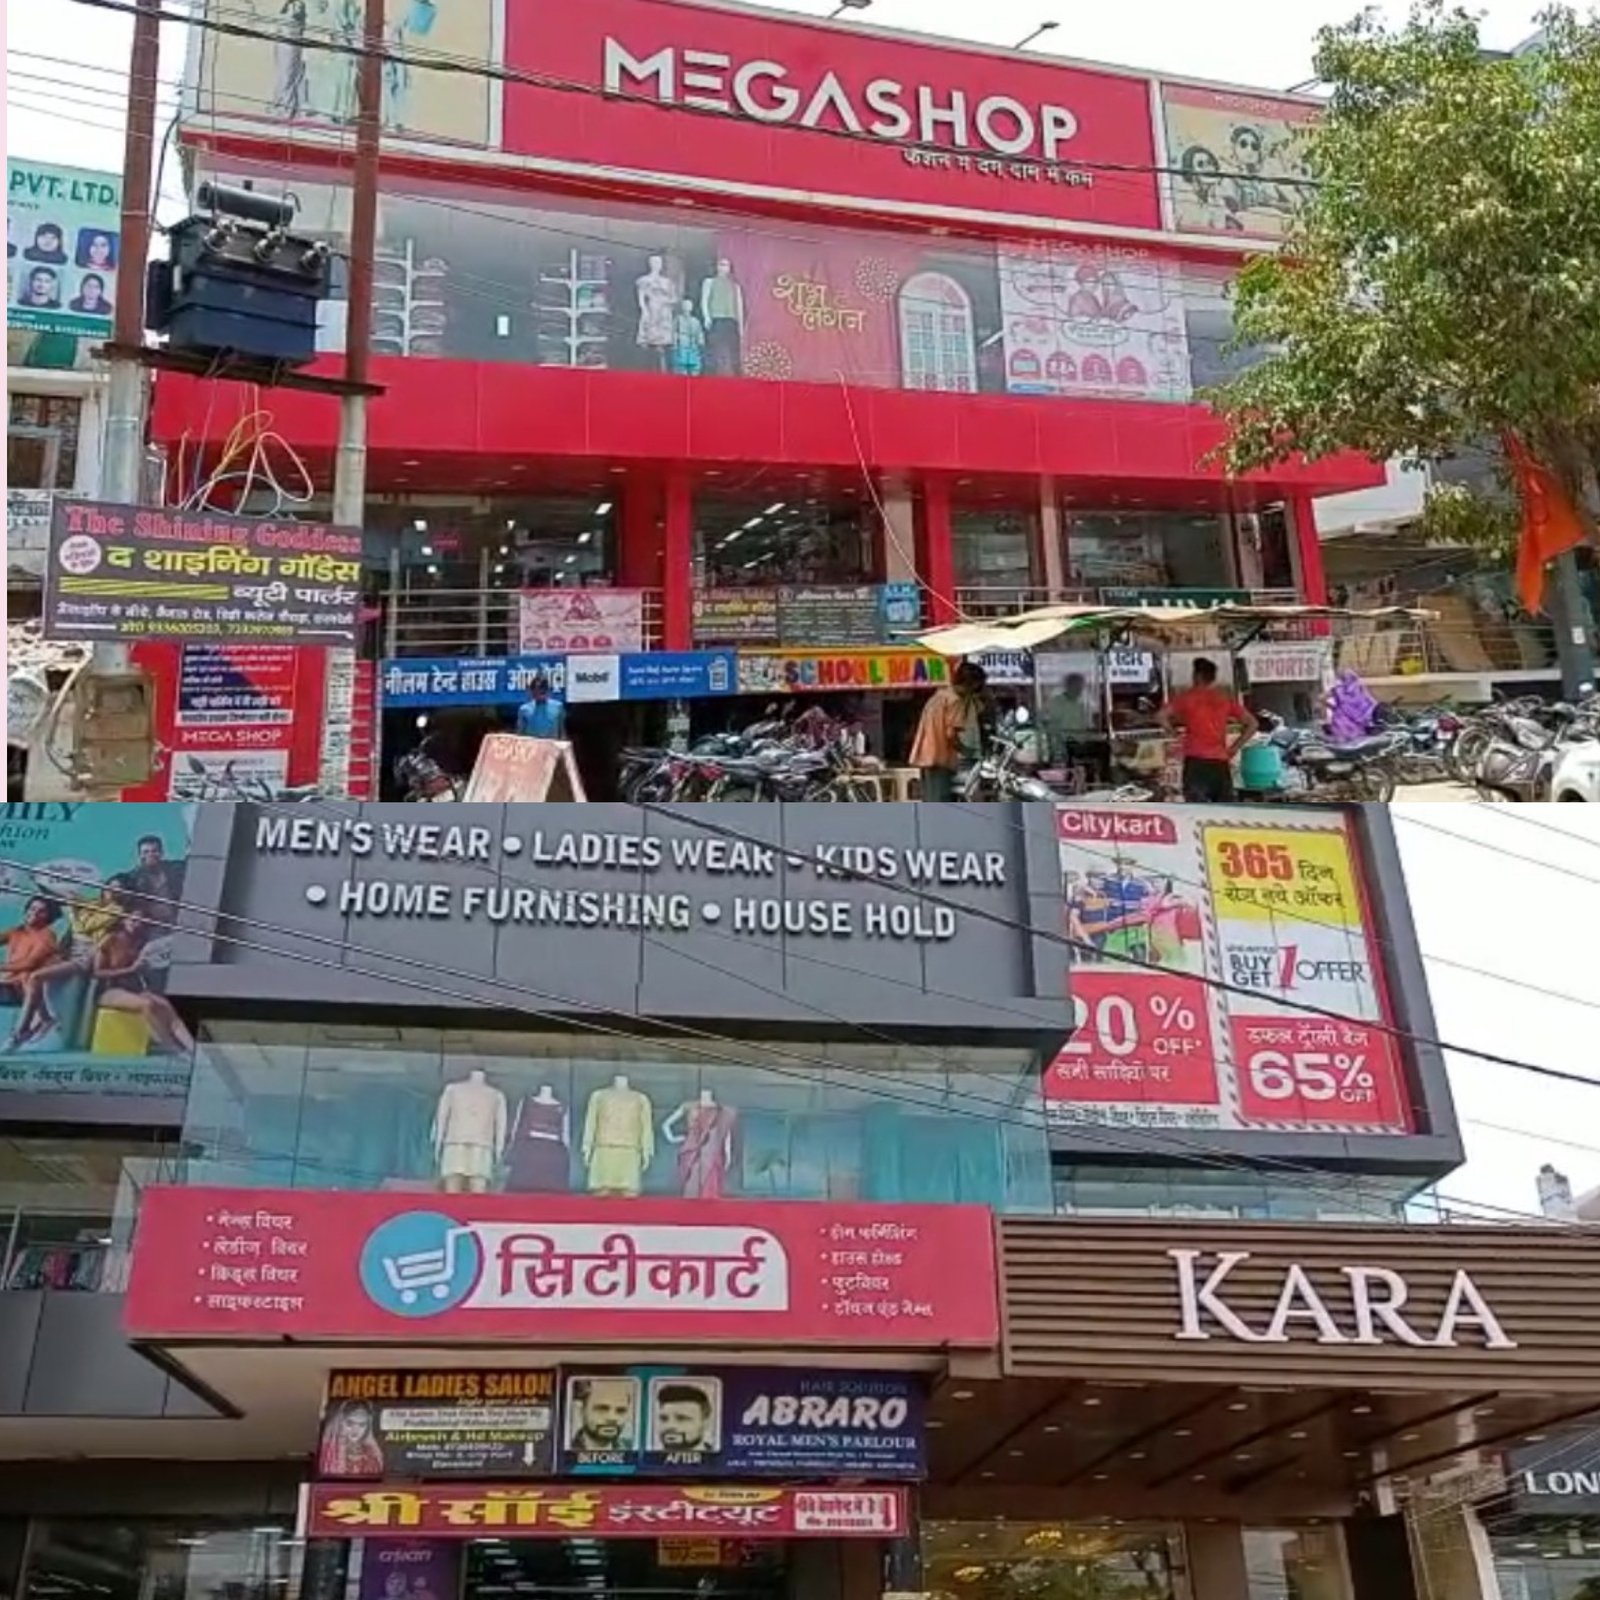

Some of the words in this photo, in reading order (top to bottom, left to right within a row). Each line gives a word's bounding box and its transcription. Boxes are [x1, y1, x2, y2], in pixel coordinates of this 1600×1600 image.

[605, 36, 1079, 160] MEGASHOP
[10, 170, 62, 198] PVT.
[70, 181, 119, 206] LTD.
[65, 505, 123, 534] The
[134, 511, 248, 547] Shining
[106, 545, 136, 568] द
[145, 545, 271, 578] शाइनिंग
[385, 667, 429, 695] नीलम
[785, 658, 884, 684] SCHOOL
[1253, 657, 1315, 677] SPORTS
[1061, 809, 1165, 839] Citykart
[255, 816, 374, 856] MEN'S
[380, 822, 491, 860] WEAR
[532, 829, 661, 868] LADIES
[671, 837, 774, 873] WEAR
[817, 842, 897, 882] KIDS
[906, 848, 1007, 883] WEAR
[1217, 841, 1294, 881] 365
[1298, 859, 1334, 882] दिन
[339, 880, 451, 915] HOME
[463, 887, 689, 929] FURNISHING
[734, 896, 852, 934] HOUSE
[866, 900, 956, 939] HOLD
[1230, 954, 1272, 972] BUY
[1232, 969, 1273, 987] GET
[1275, 944, 1299, 990] 1
[1296, 959, 1366, 983] OFFER
[1249, 1050, 1374, 1102] 65%
[496, 1231, 767, 1300] सिटीकार्ट
[1167, 1249, 1517, 1349] KARA
[331, 1374, 398, 1398] ANGEL
[404, 1374, 480, 1398] LADIES
[485, 1372, 553, 1396] SALON
[742, 1394, 908, 1430] ABRARO
[666, 1451, 703, 1465] AFTER
[733, 1433, 788, 1447] ROYAL
[792, 1434, 840, 1448] MEN'S
[843, 1435, 917, 1449] PARLOUR
[1524, 1470, 1600, 1495] LON
[320, 1491, 431, 1525] श्री
